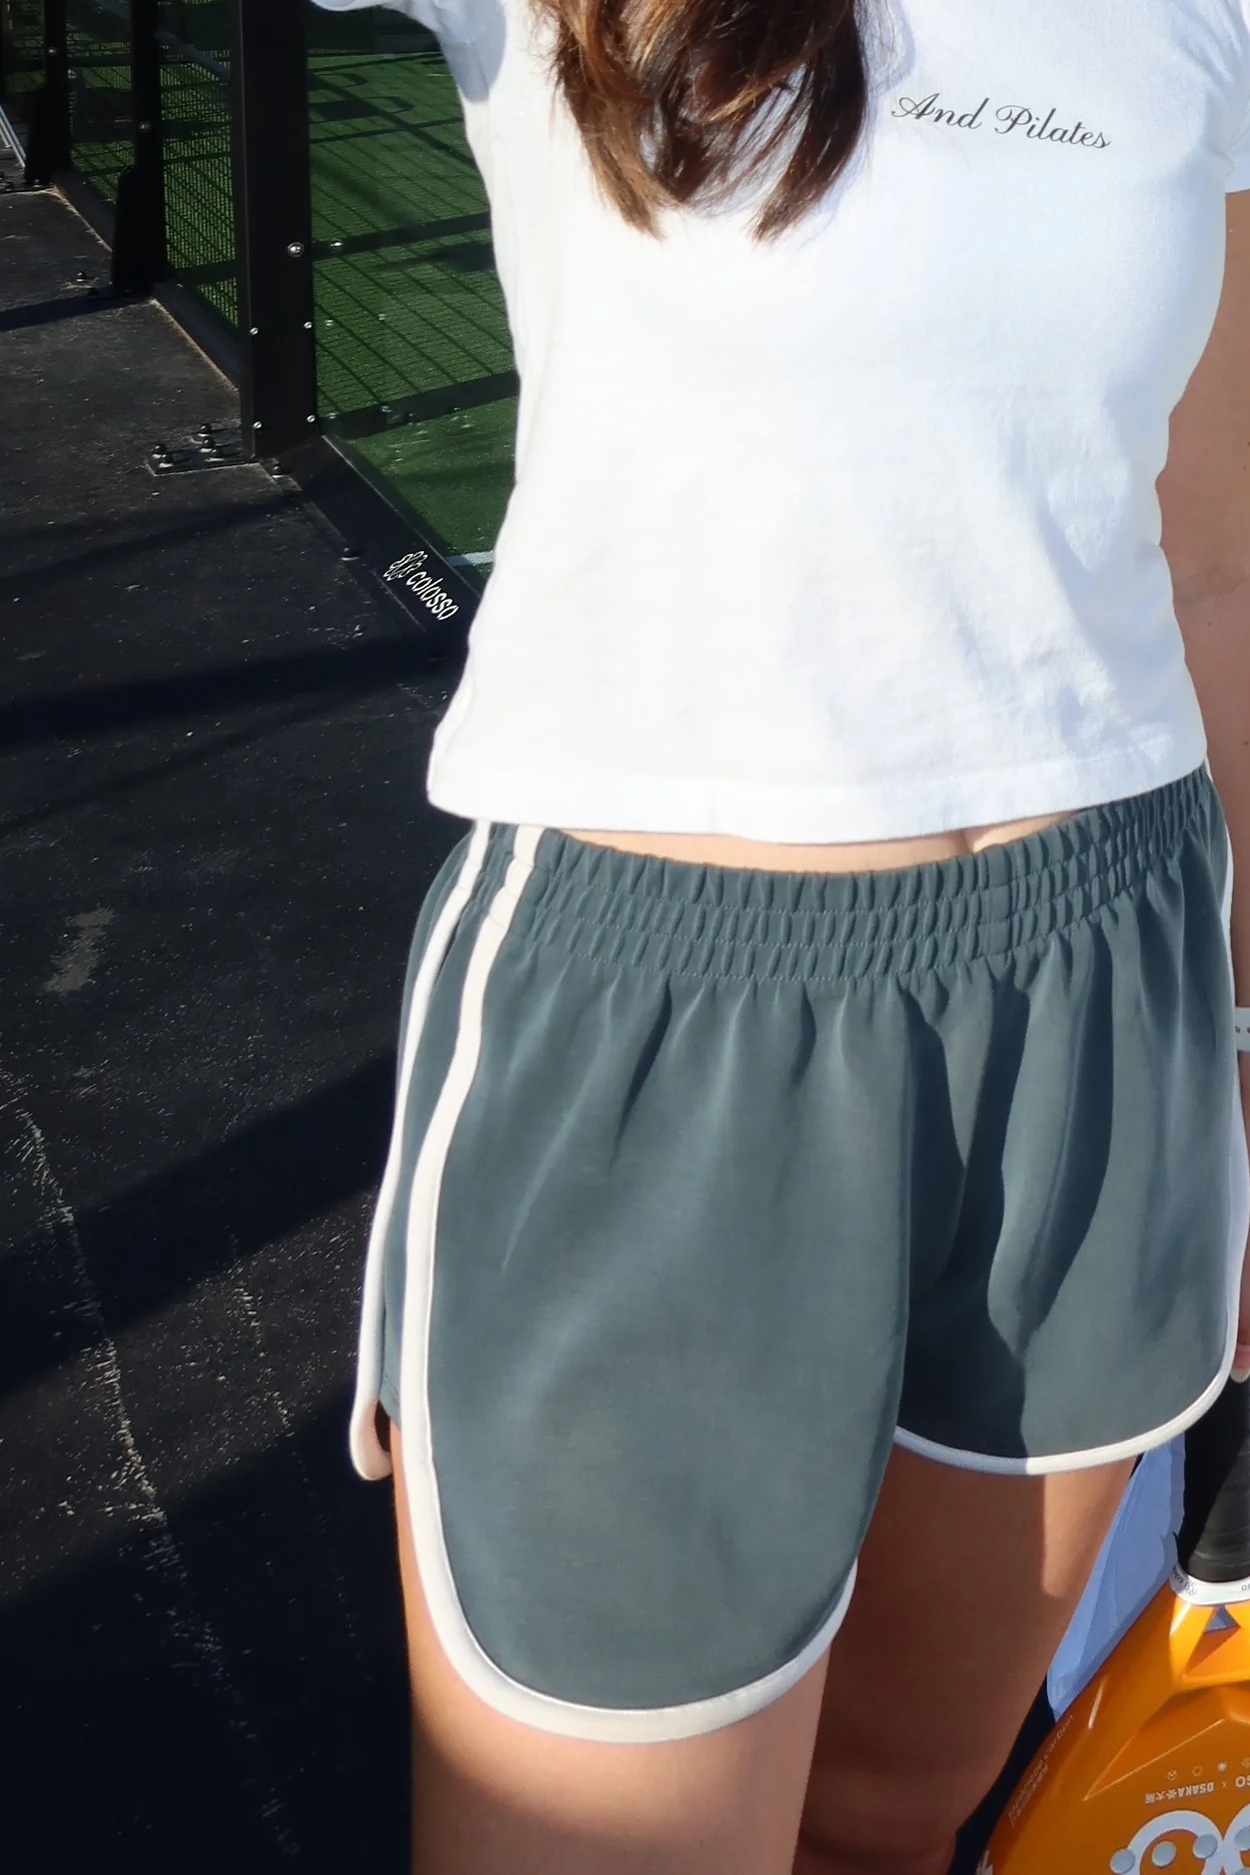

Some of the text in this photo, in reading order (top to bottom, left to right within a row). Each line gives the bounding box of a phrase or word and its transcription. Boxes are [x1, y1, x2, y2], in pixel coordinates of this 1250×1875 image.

[891, 93, 1111, 149] And Pilates
[406, 571, 460, 621] colosso
